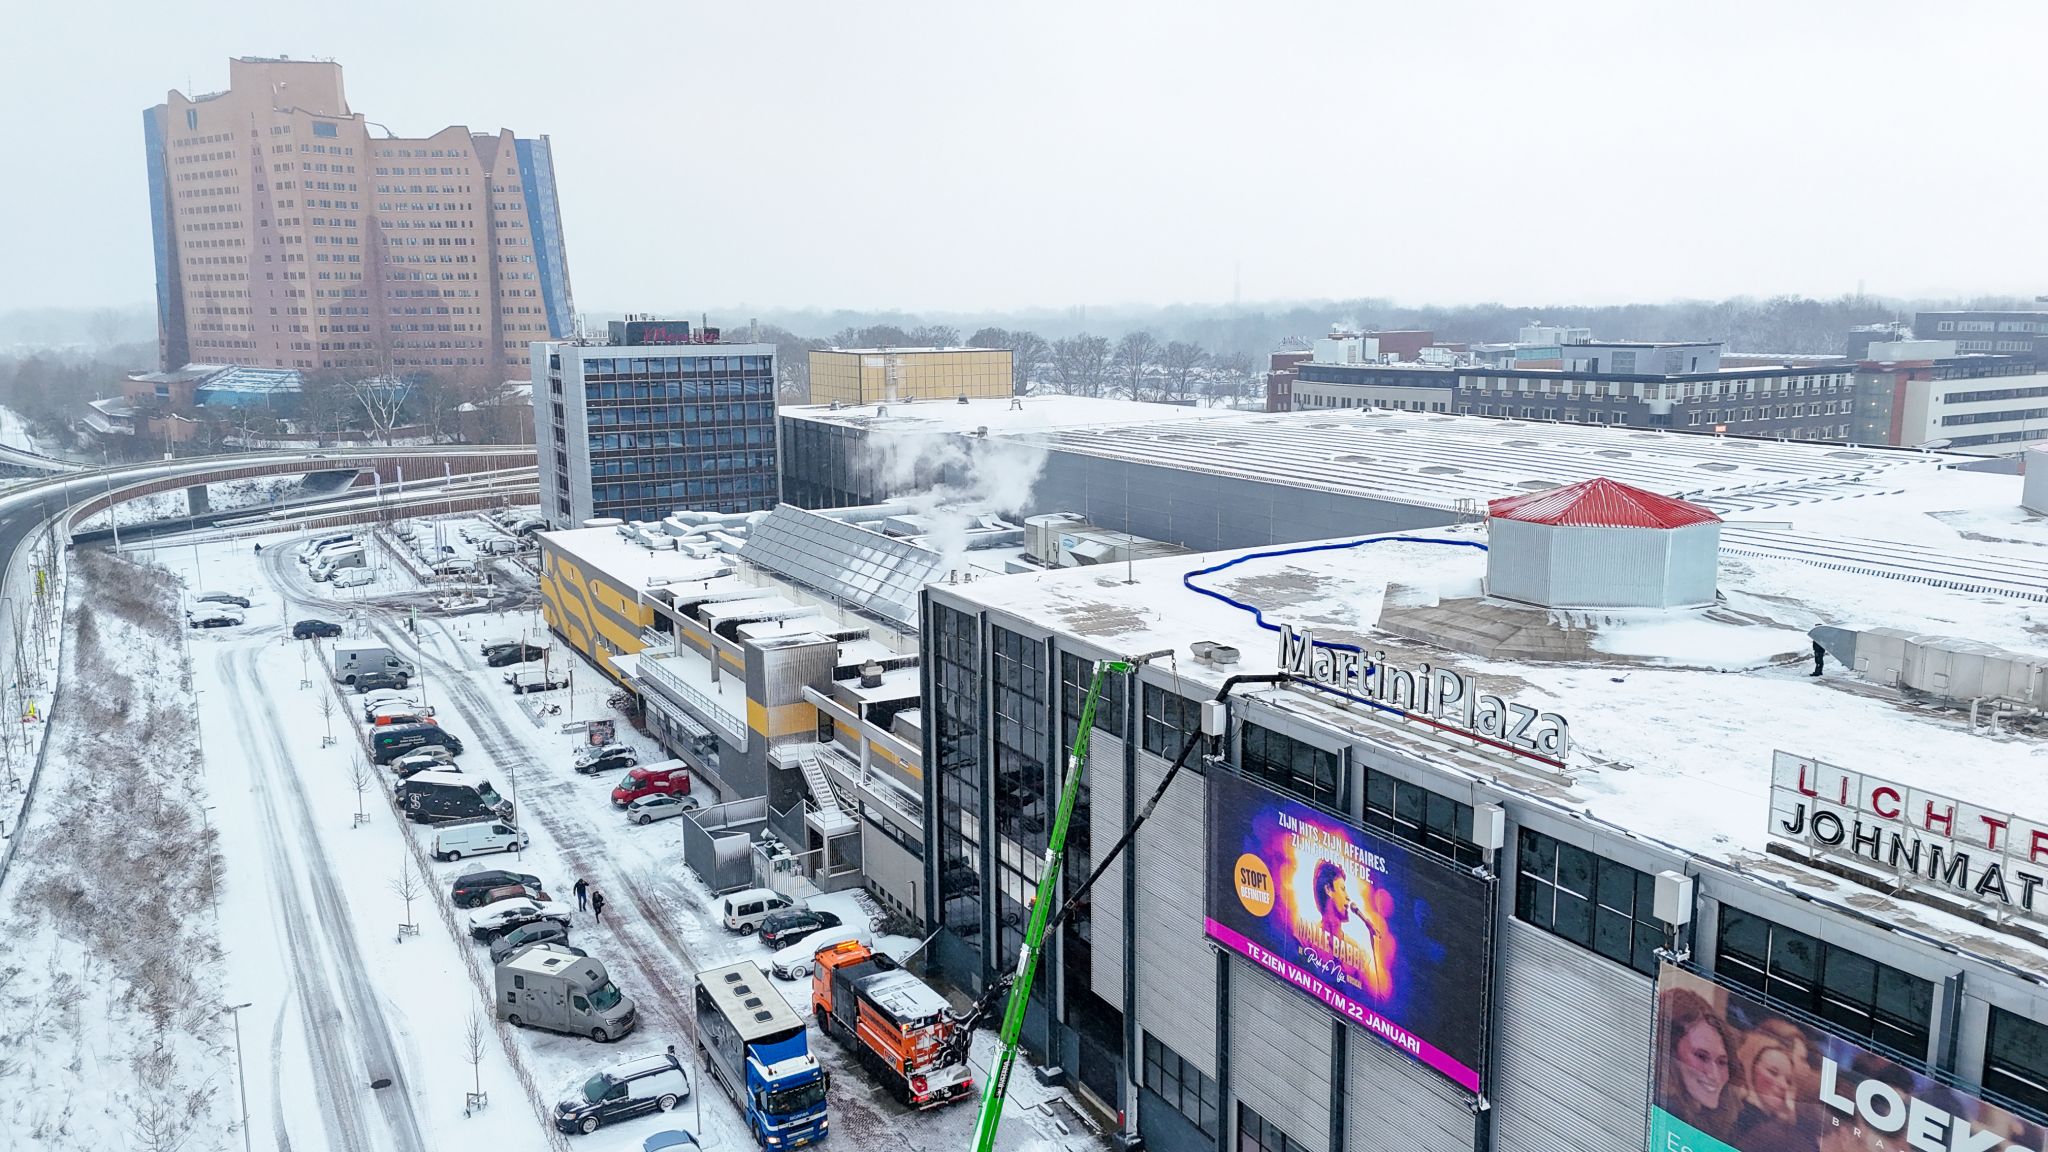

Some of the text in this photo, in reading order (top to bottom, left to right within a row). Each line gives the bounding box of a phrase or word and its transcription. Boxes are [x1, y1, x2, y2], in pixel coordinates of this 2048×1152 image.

[1278, 623, 1570, 759] MartiniPlaza
[1240, 867, 1267, 891] STOPT
[1278, 811, 1298, 833] ZIJN
[1322, 830, 1342, 852] ZIJN
[1344, 841, 1389, 875] AFFAIRES.
[1247, 942, 1421, 1054] TE ZIEN VAN 17 T/M 22 JANUARI
[1820, 1056, 2048, 1152] LOEK
